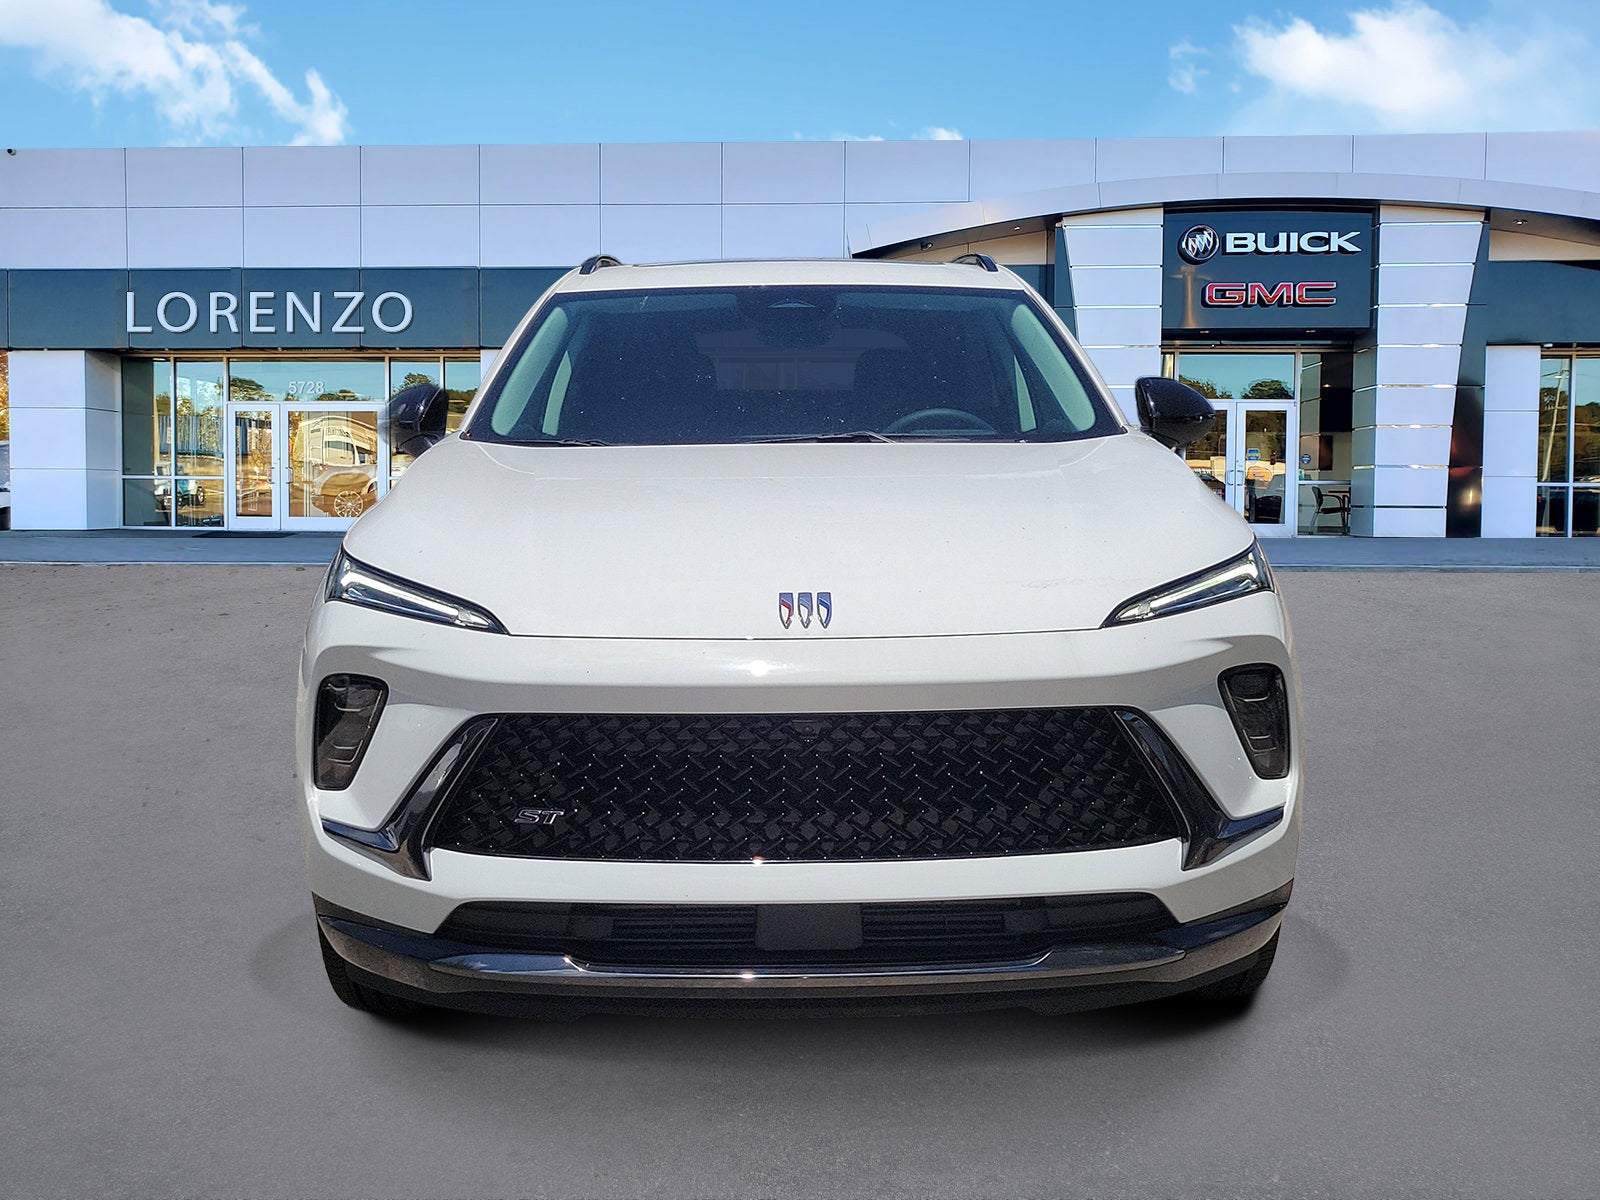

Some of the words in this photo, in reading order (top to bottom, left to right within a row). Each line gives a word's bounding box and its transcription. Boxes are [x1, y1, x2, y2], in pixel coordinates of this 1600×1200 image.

[1225, 230, 1362, 253] BUICK
[1205, 281, 1338, 305] GMC
[125, 291, 414, 333] LORENZO
[287, 380, 325, 395] 5728
[513, 808, 565, 825] ST
